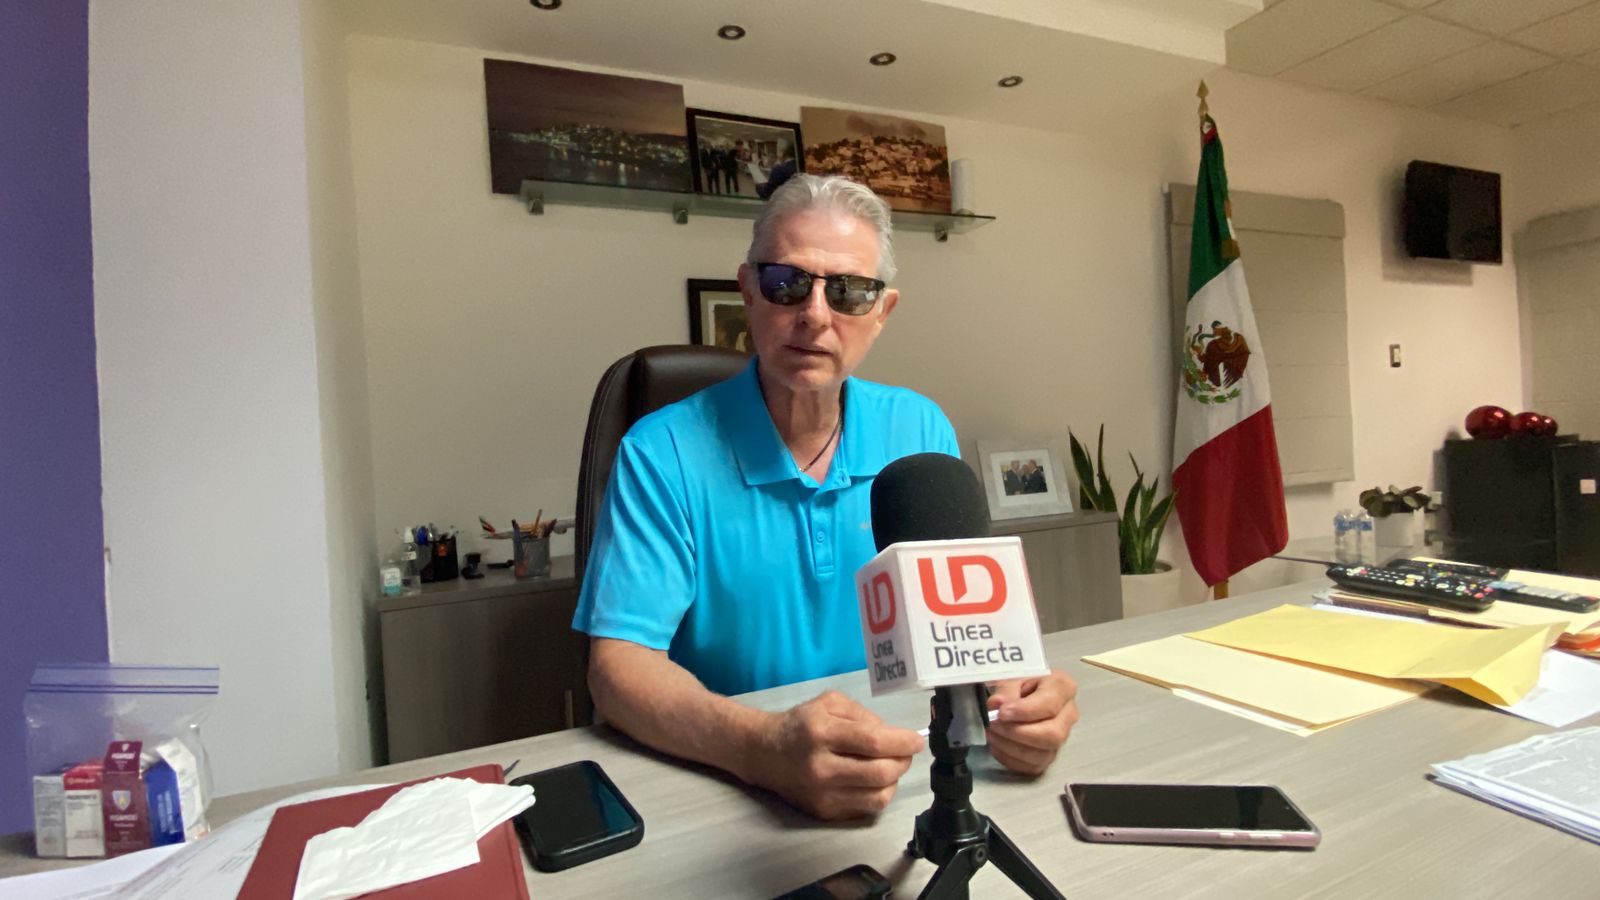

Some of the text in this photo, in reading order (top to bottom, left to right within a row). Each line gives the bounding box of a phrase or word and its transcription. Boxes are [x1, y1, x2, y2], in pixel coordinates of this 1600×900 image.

[930, 621, 993, 643] Línea
[934, 641, 1024, 669] Directa
[874, 656, 907, 682] Directa
